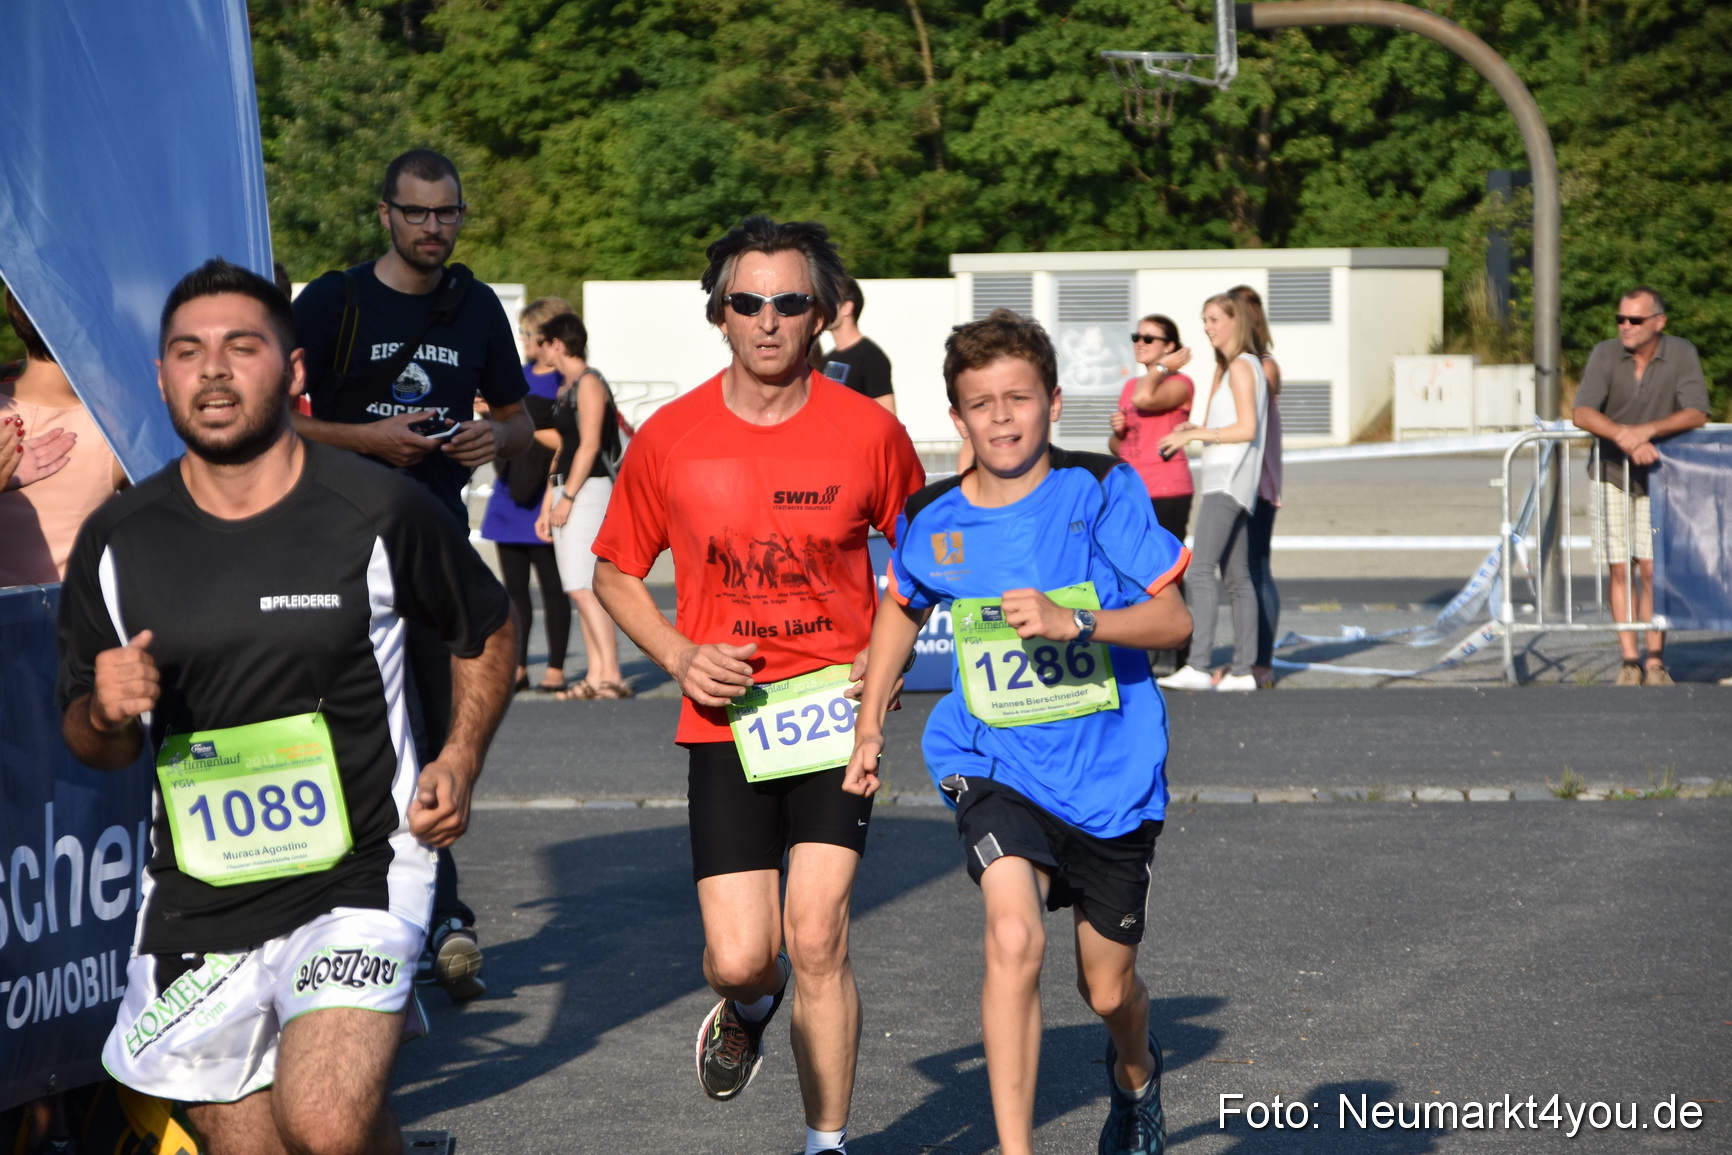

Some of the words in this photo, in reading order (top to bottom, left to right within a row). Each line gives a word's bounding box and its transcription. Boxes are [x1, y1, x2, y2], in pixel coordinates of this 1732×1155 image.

[370, 342, 459, 367] EISAREN
[773, 491, 819, 504] swn
[272, 594, 341, 609] PFLEIDERER
[732, 620, 778, 638] Alles
[784, 616, 833, 636] läuft
[975, 641, 1096, 692] 1286
[991, 700, 1025, 709] Hannes
[1026, 689, 1089, 706] Bierschneider
[748, 697, 855, 751] 1529
[183, 752, 241, 771] firmenlauf
[188, 779, 326, 841] 1089
[223, 848, 260, 861] Muraca
[262, 841, 308, 855] Agostino
[194, 1000, 228, 1028] Gym
